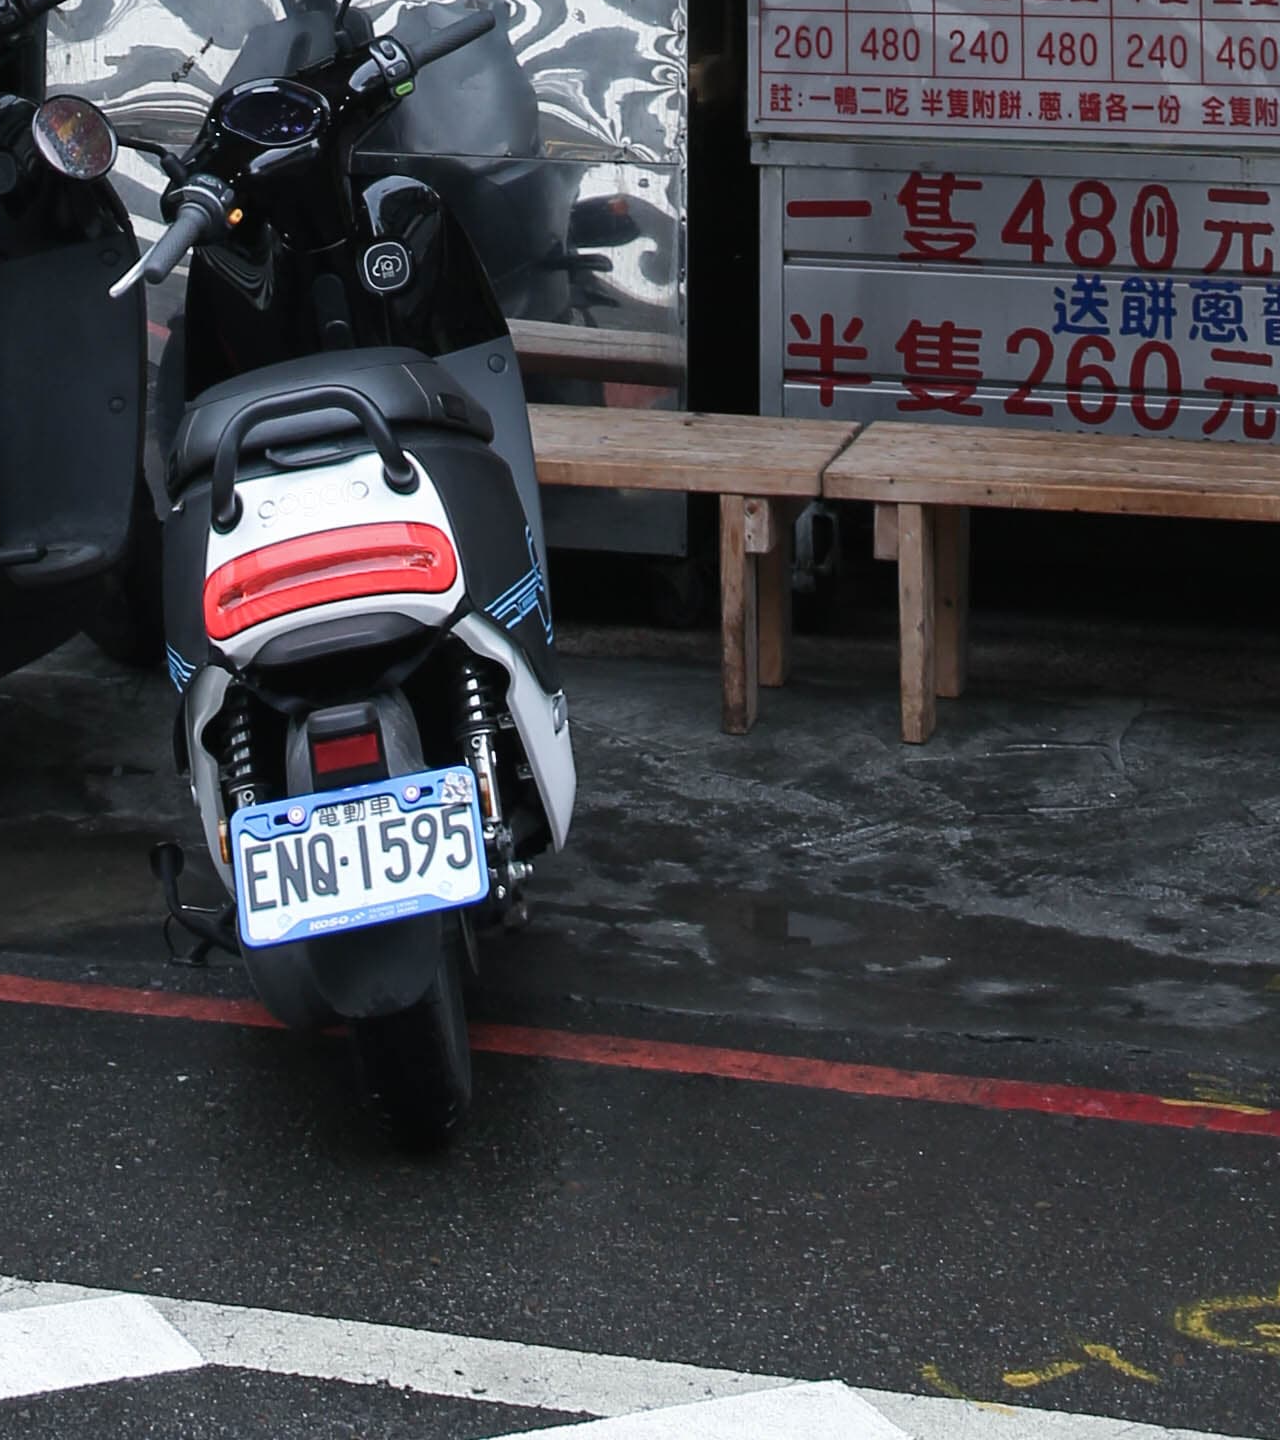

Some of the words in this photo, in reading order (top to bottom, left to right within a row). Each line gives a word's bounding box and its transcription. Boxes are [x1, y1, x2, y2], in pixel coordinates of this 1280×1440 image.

[774, 25, 833, 60] 260
[860, 27, 921, 61] 480
[949, 30, 1009, 64] 240
[1036, 32, 1098, 67] 480
[1126, 34, 1188, 69] 240
[1217, 36, 1279, 71] 460
[786, 171, 1274, 277] 一隻480元
[786, 313, 1279, 441] 半隻260元
[318, 795, 392, 827] 電動車
